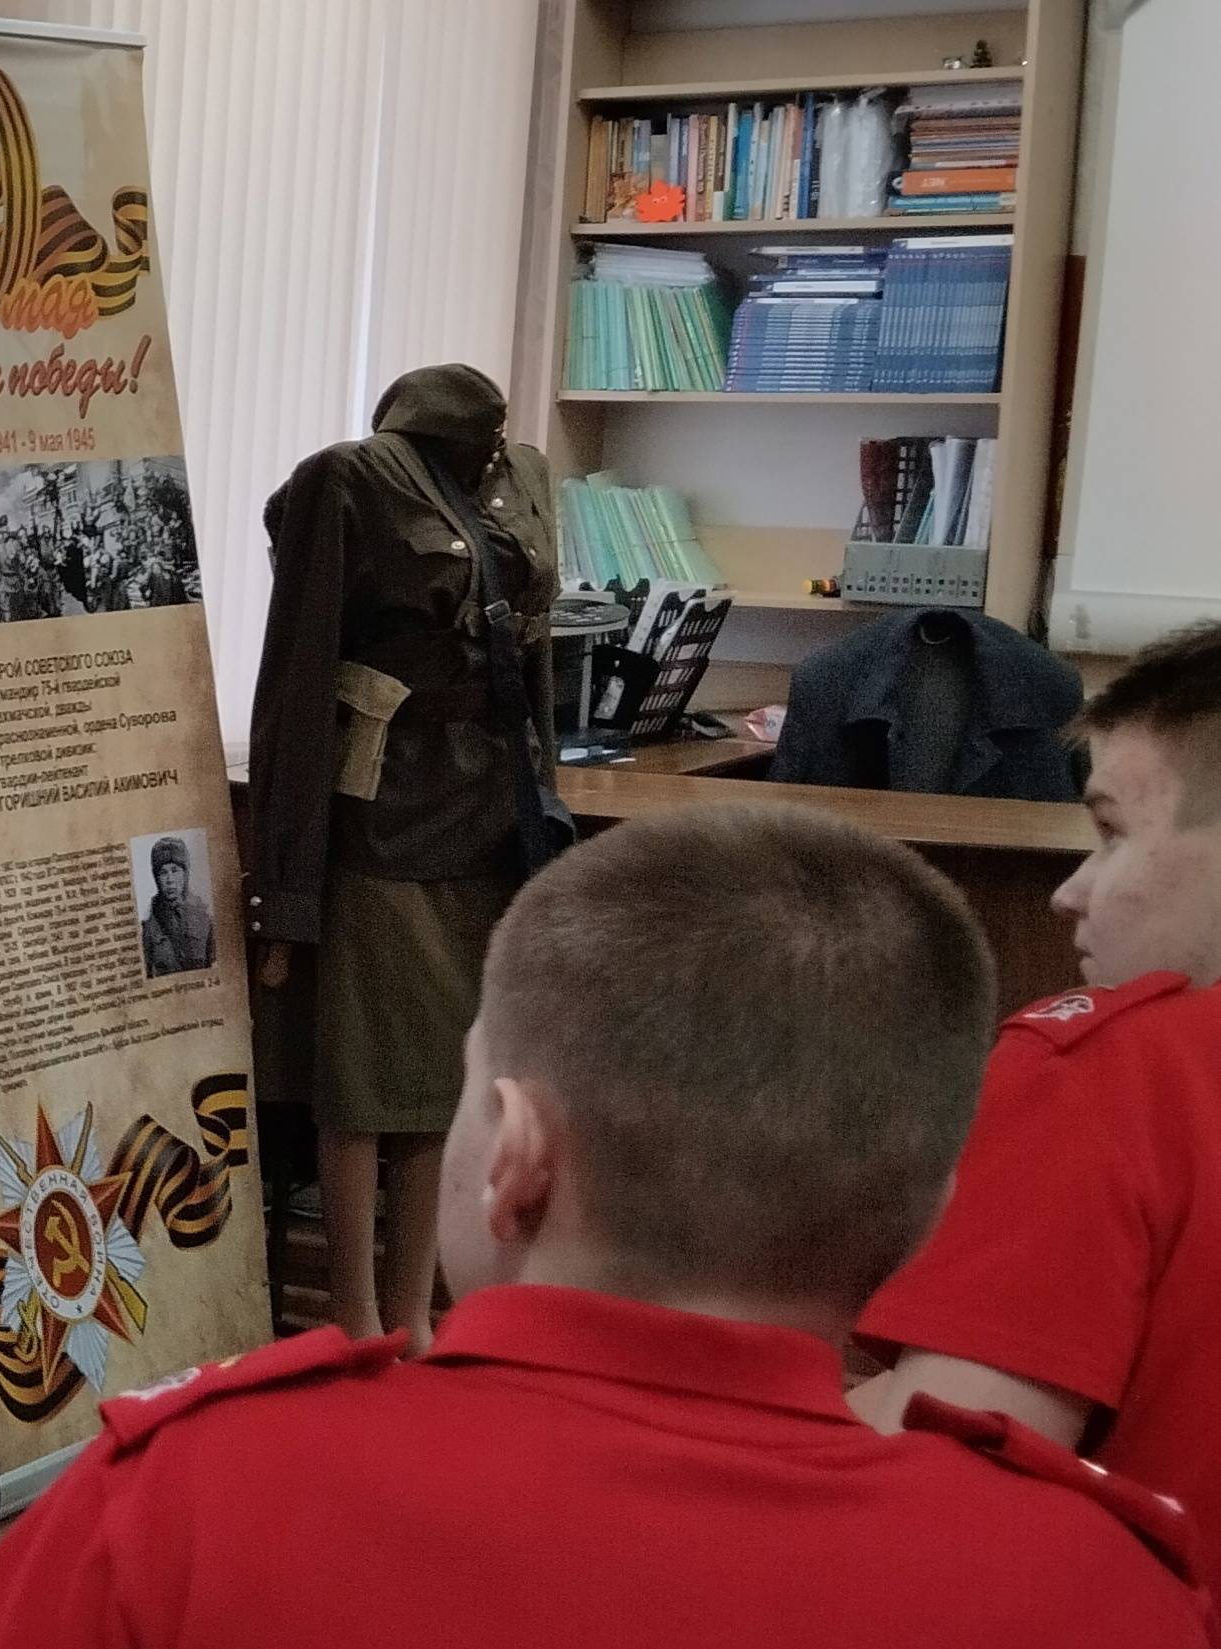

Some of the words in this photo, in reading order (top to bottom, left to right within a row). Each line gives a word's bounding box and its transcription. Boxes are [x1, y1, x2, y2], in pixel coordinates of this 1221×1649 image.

[9, 335, 151, 419] победы!
[28, 429, 36, 452] 9
[39, 434, 63, 451] мая
[66, 427, 96, 451] 1945
[25, 653, 92, 676] СОВЕТСКОГО
[94, 649, 134, 668] СОЮЗА
[119, 710, 177, 730] Суворова
[62, 776, 110, 802] ВАСИЛИЙ
[113, 769, 178, 794] АКИМОВИЧ
